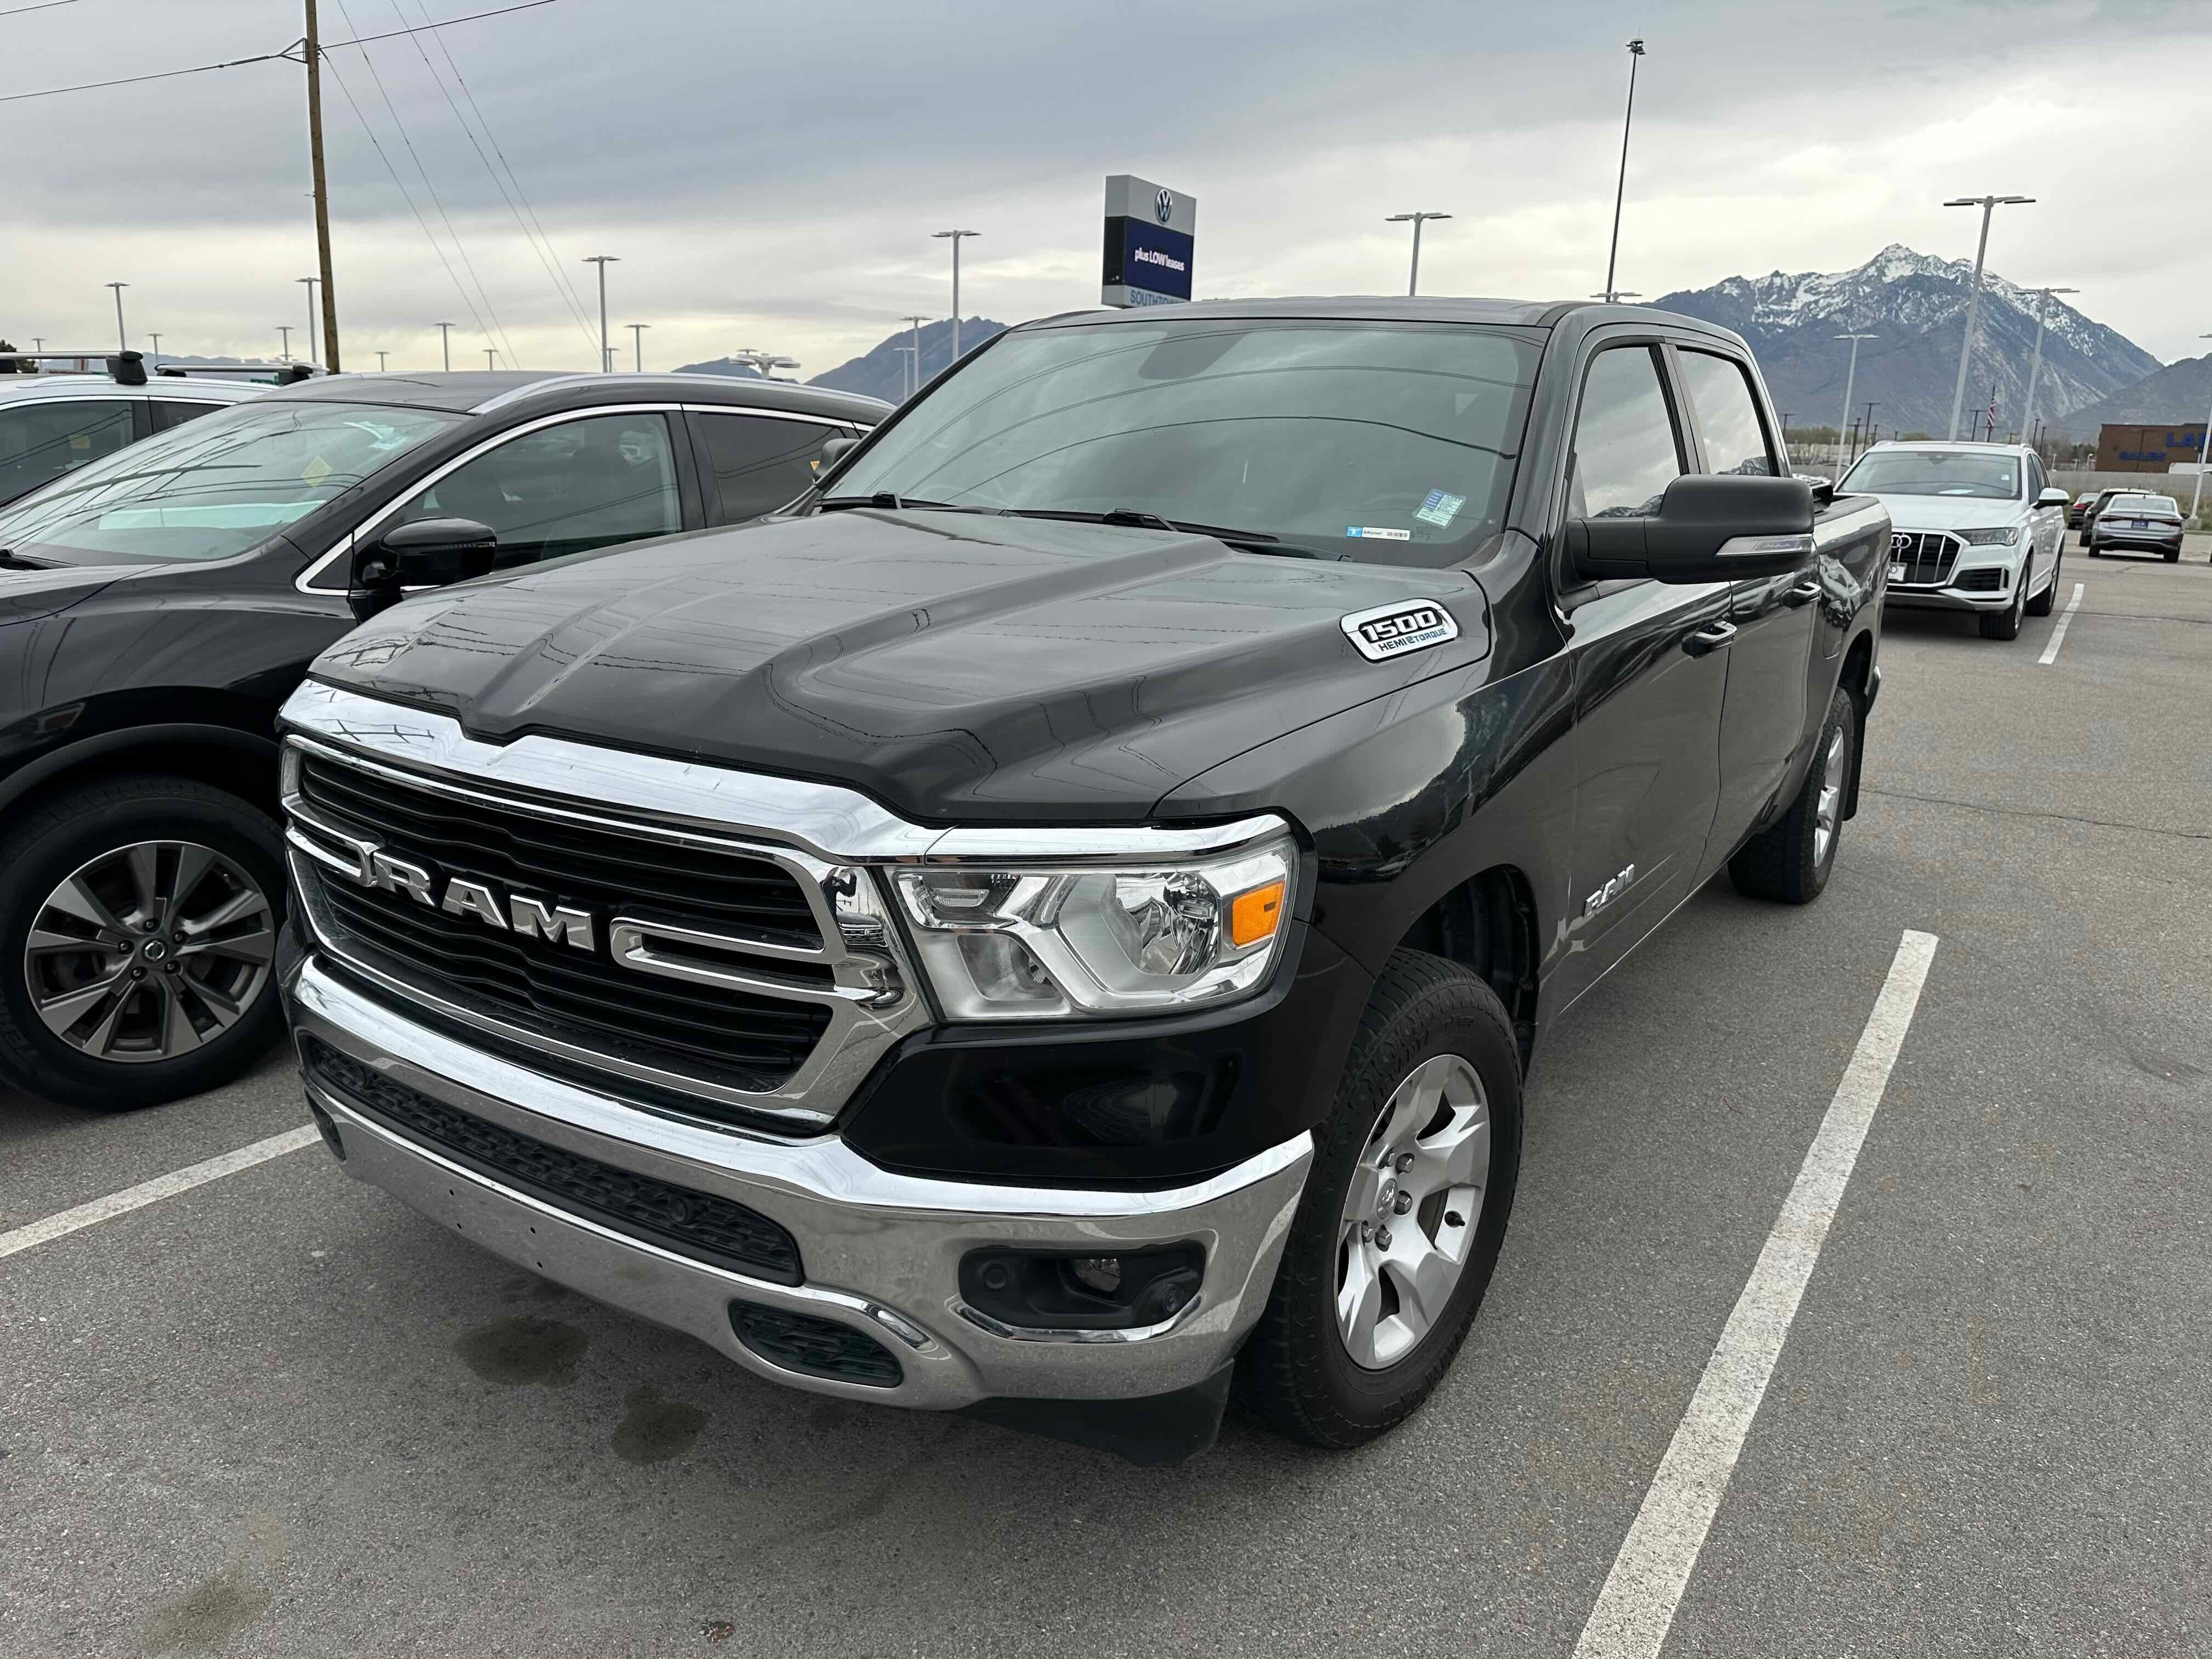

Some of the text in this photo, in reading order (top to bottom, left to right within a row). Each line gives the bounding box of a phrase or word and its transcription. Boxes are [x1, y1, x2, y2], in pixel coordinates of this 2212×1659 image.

[1134, 247, 1185, 271] plus LOW leases
[1360, 610, 1437, 642] 1500
[1378, 637, 1407, 652] HEMI
[371, 849, 596, 953] RAM
[1583, 864, 1635, 917] RAM
